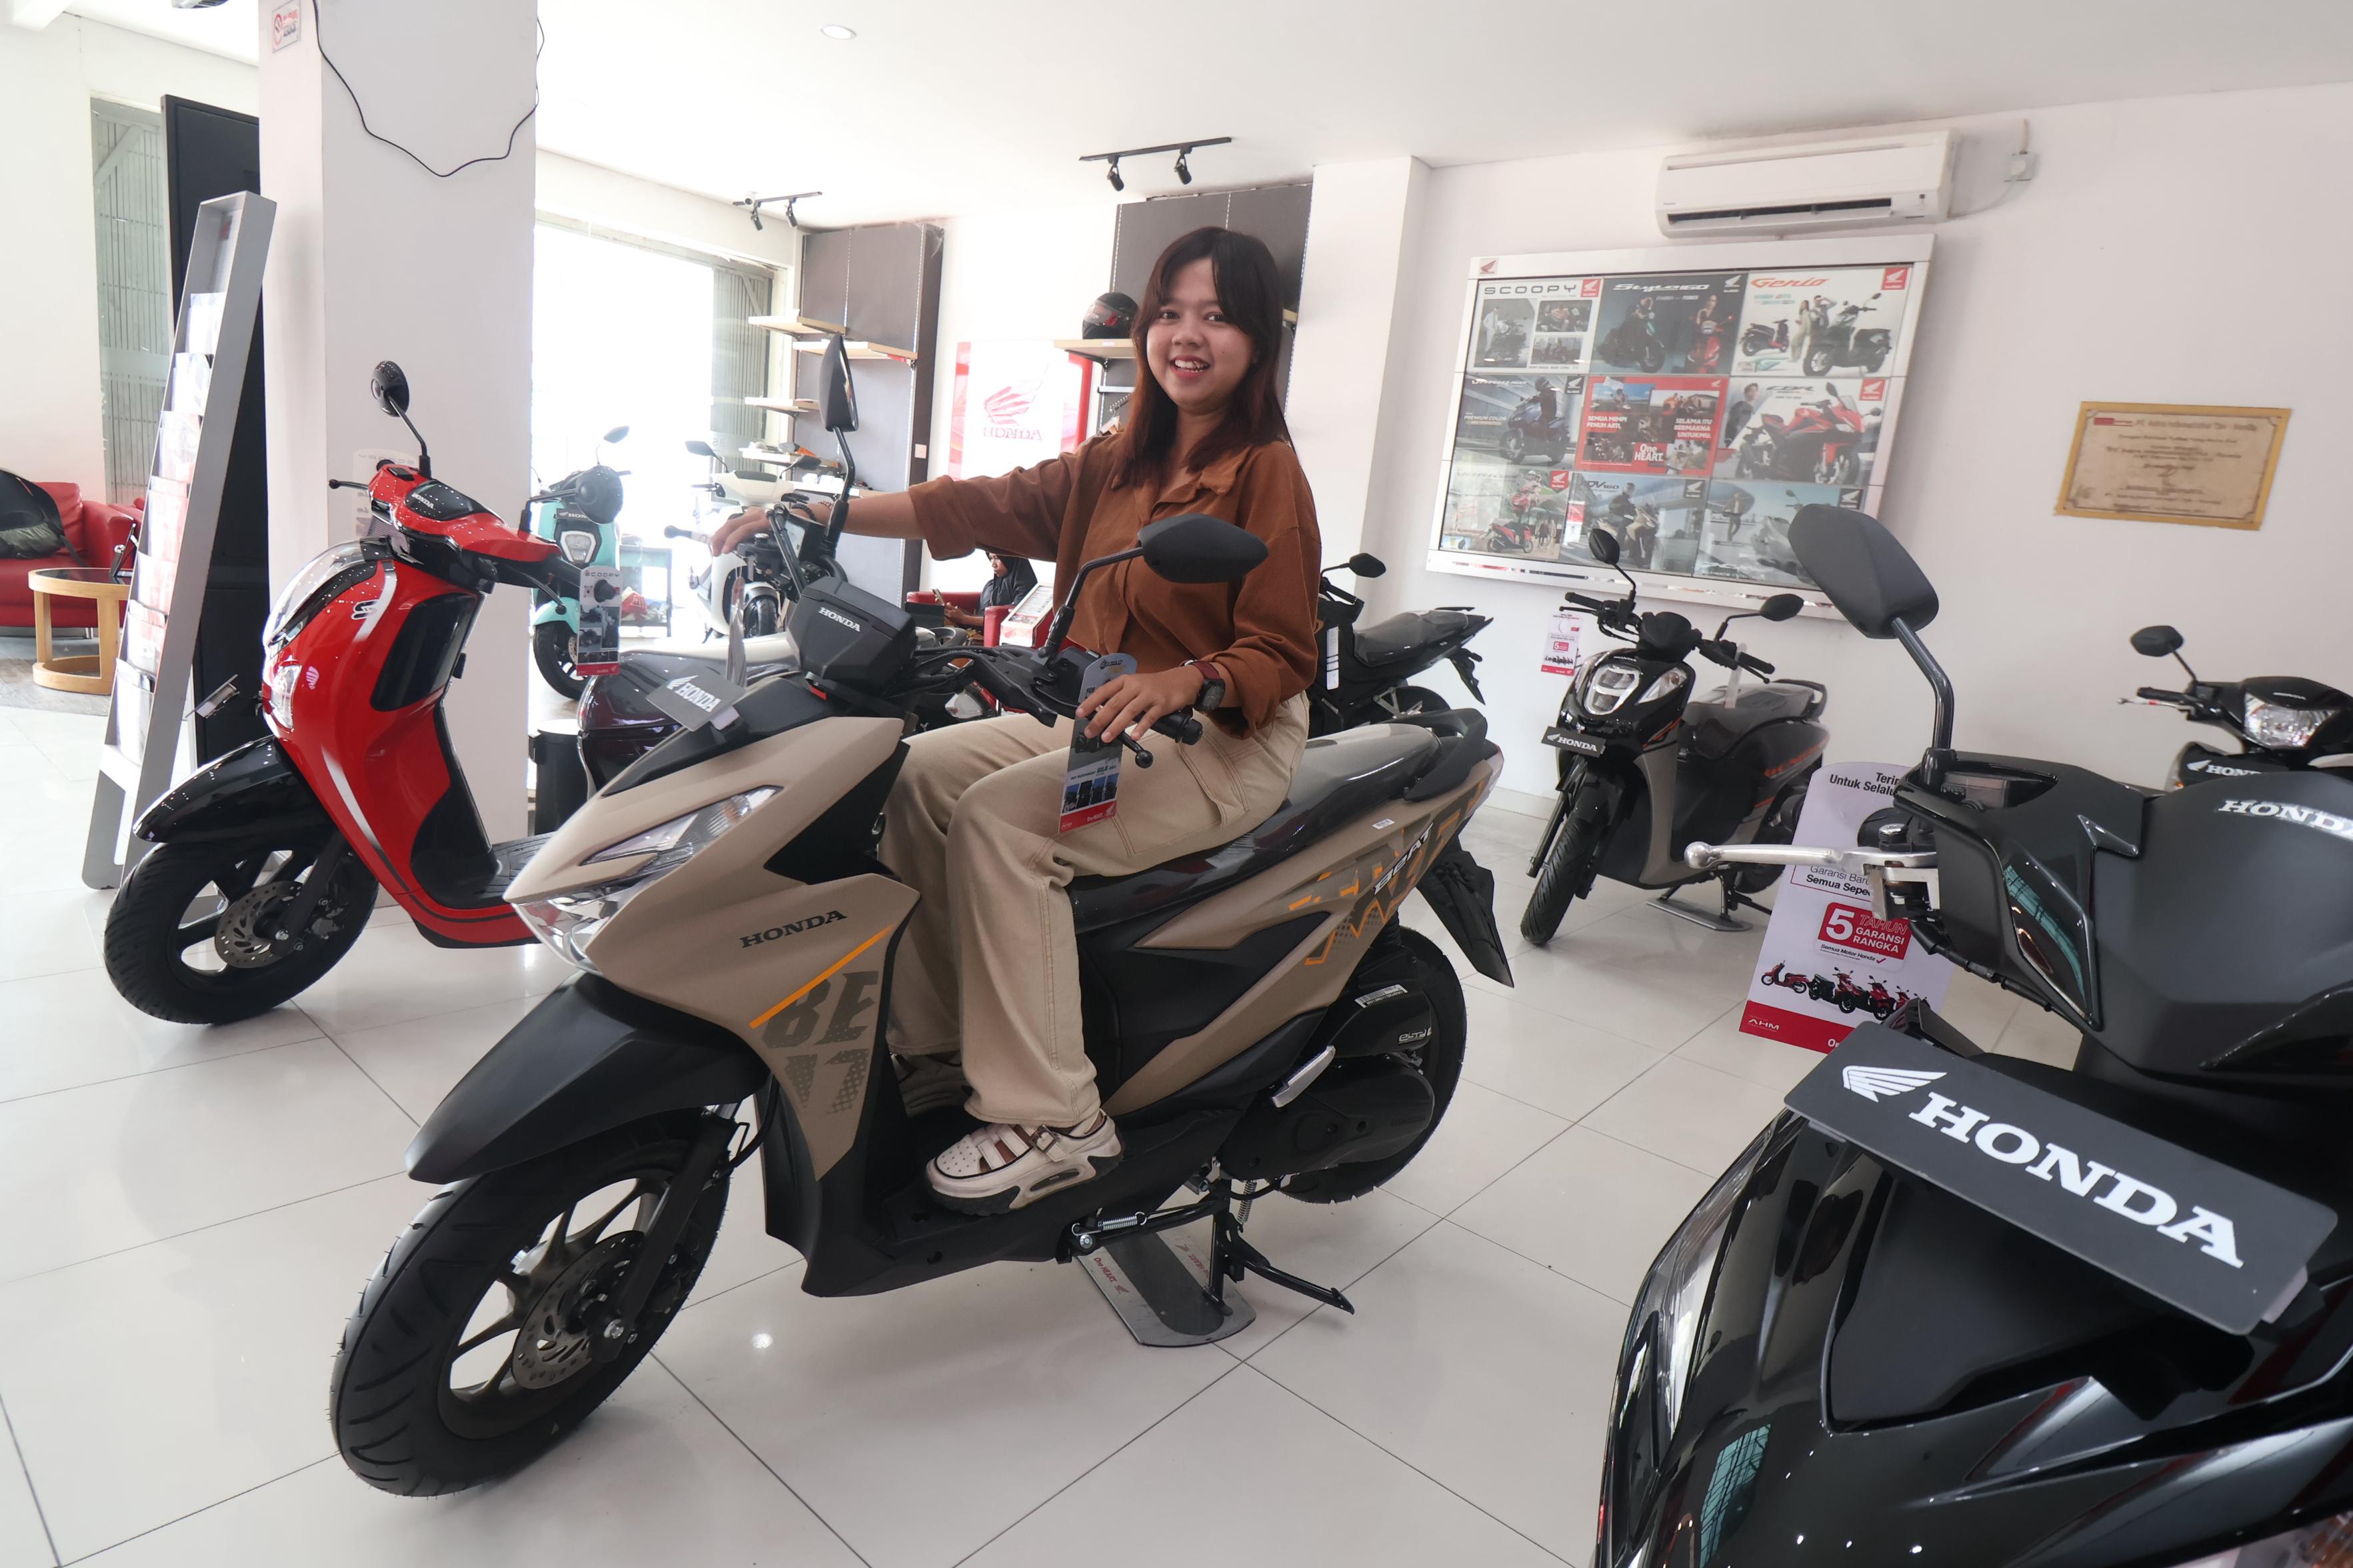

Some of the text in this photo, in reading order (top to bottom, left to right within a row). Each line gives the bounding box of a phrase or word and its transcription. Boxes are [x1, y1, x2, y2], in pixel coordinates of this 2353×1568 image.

[1484, 285, 1577, 295] SCOOPY
[1750, 277, 1830, 288] Genio
[1640, 443, 1658, 453] One
[818, 607, 861, 632] HONDA
[675, 682, 722, 713] HONDA
[1557, 736, 1597, 752] HONDA
[2206, 764, 2261, 776] HON
[1830, 774, 1861, 790] Untuk
[2218, 800, 2353, 834] HOND
[1810, 866, 1846, 880] Garansi
[1806, 874, 1870, 897] Semua Sepe
[740, 910, 847, 948] HONDA
[1826, 908, 1908, 941] 5 TAHUN
[1852, 935, 1899, 954] RANGKA
[1855, 927, 1904, 945] GARANSI
[1820, 944, 1840, 953] Semua
[1827, 1038, 1840, 1048] On
[1908, 1091, 2244, 1269] HONDA
[1101, 1266, 1117, 1283] HEART
